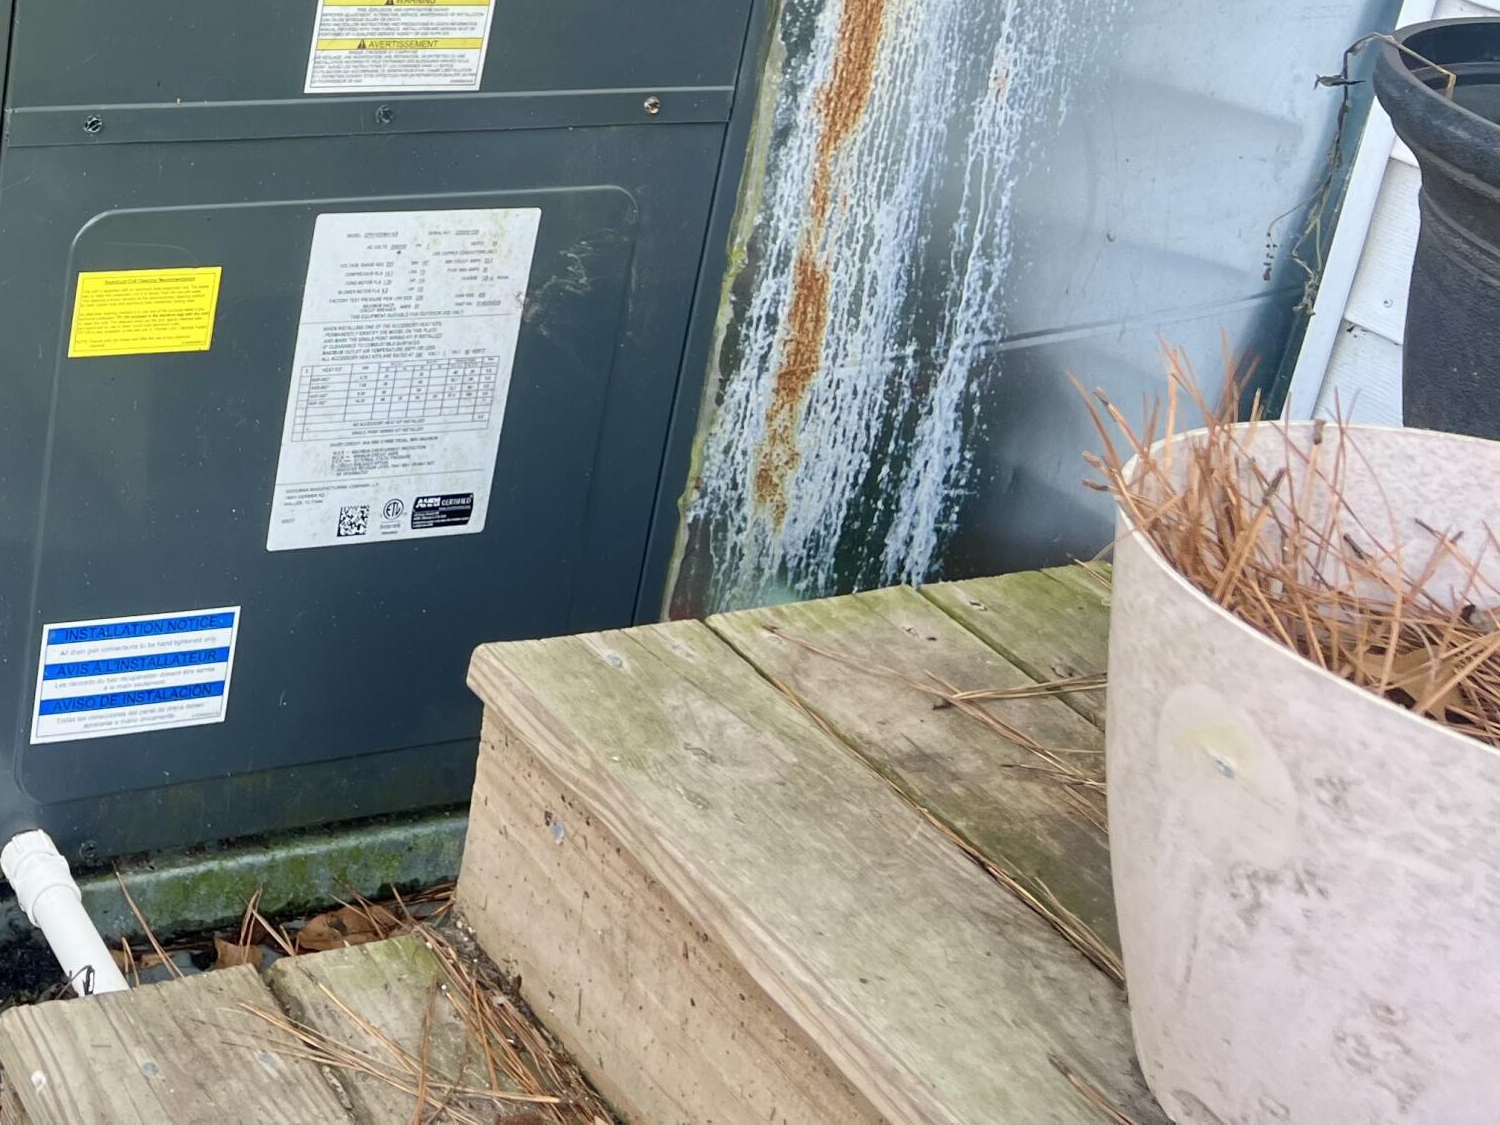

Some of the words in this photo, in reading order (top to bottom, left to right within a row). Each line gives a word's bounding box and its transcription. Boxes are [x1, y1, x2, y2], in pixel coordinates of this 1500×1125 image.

[368, 40, 439, 48] AVERTISSEMENT
[65, 620, 164, 641] INSTALLATION
[167, 616, 219, 631] NOTICE
[57, 663, 88, 675] AVIS
[105, 650, 217, 671] L'INSTALLATEUR
[52, 698, 96, 712] AVISO
[100, 696, 117, 707] DE
